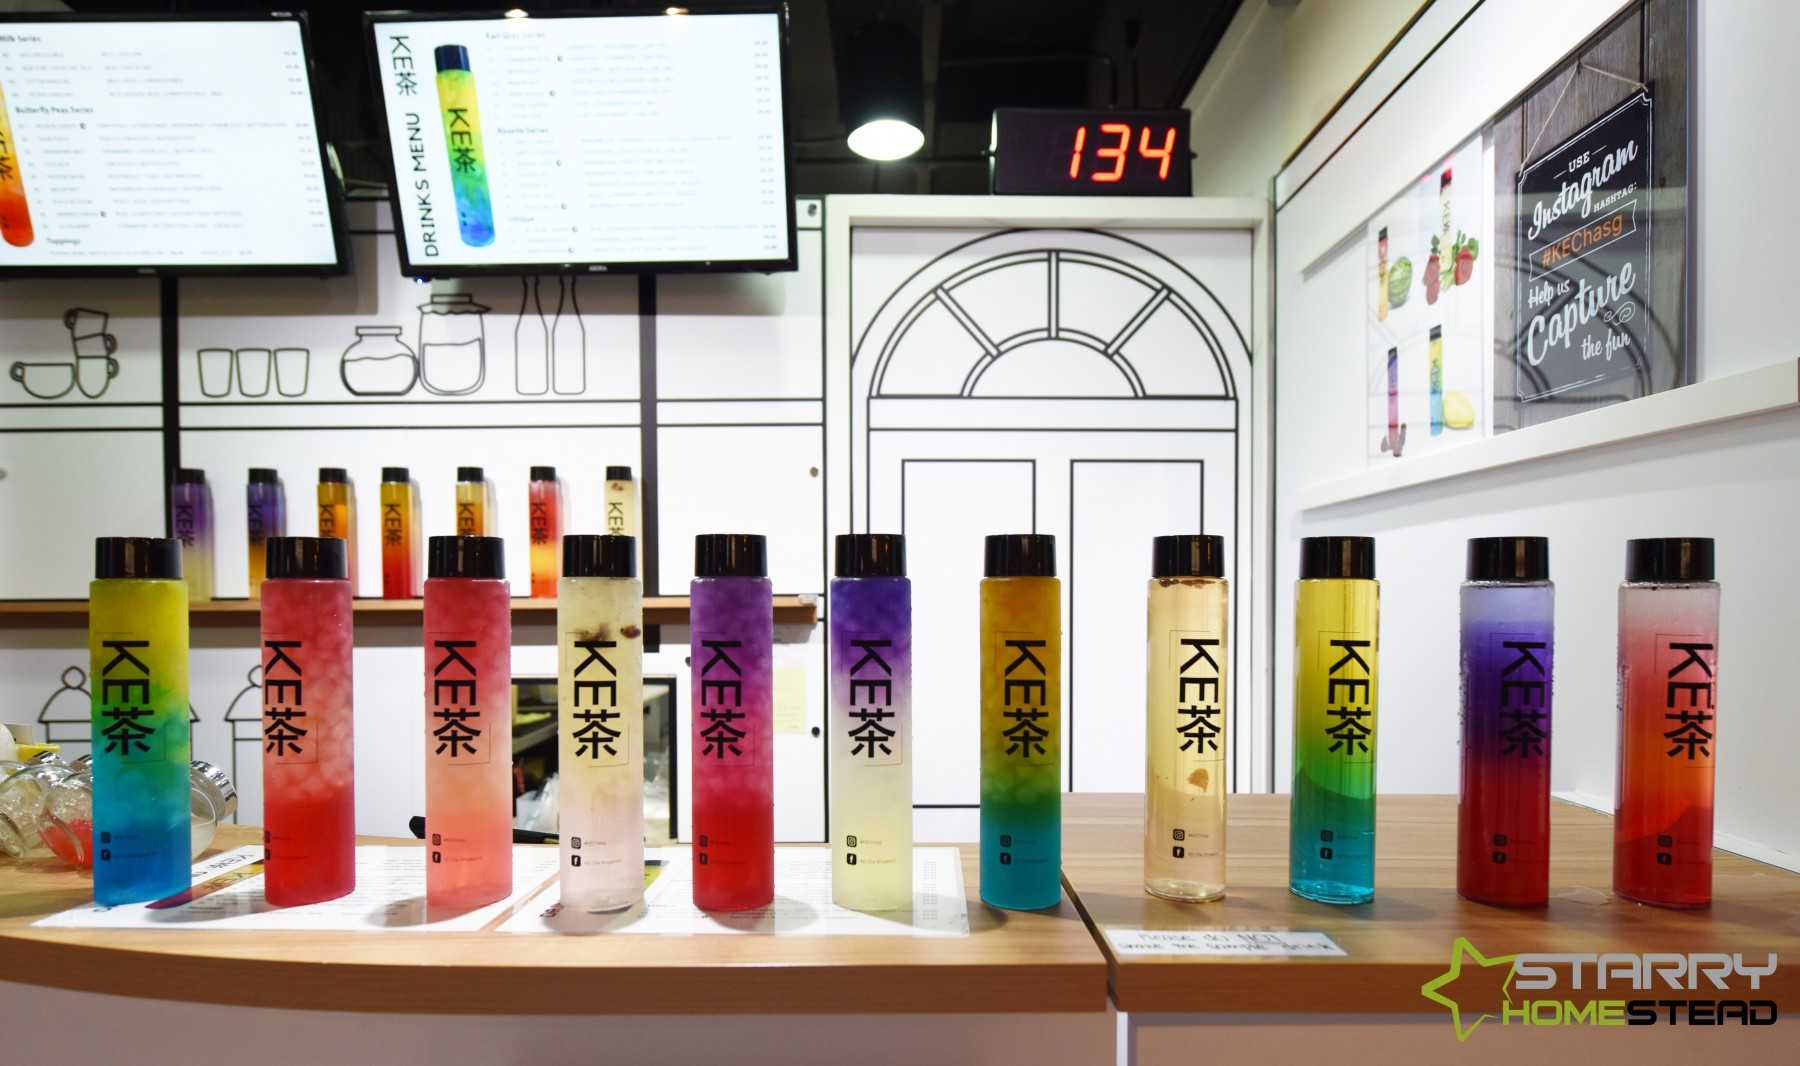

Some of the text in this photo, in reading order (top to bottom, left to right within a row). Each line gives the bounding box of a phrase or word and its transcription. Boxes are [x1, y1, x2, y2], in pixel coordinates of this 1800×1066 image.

[389, 36, 418, 96] KE茶
[405, 112, 439, 256] DRINKS MENU
[448, 108, 476, 174] KE茶
[1069, 122, 1176, 182] 134
[1528, 139, 1638, 240] Instagram
[1568, 151, 1590, 173] USE
[1541, 213, 1623, 269] #KEChasg
[1593, 183, 1637, 213] HASHTAG:
[1527, 262, 1636, 366] Capture
[1528, 279, 1571, 309] Help us
[1580, 328, 1631, 361] the fun
[384, 503, 402, 545] KE茶
[531, 502, 549, 544] KE茶
[102, 640, 155, 756] KE茶
[264, 640, 307, 756] KE茶
[433, 640, 481, 757] KE茶
[572, 640, 621, 759] KE茶
[700, 640, 746, 758] KE茶
[848, 640, 895, 758] KE茶
[1002, 640, 1049, 758] KE茶
[1176, 638, 1221, 754] KE茶
[1325, 640, 1372, 755] KE茶
[1502, 640, 1547, 758] KE茶
[1664, 642, 1713, 760] KE茶
